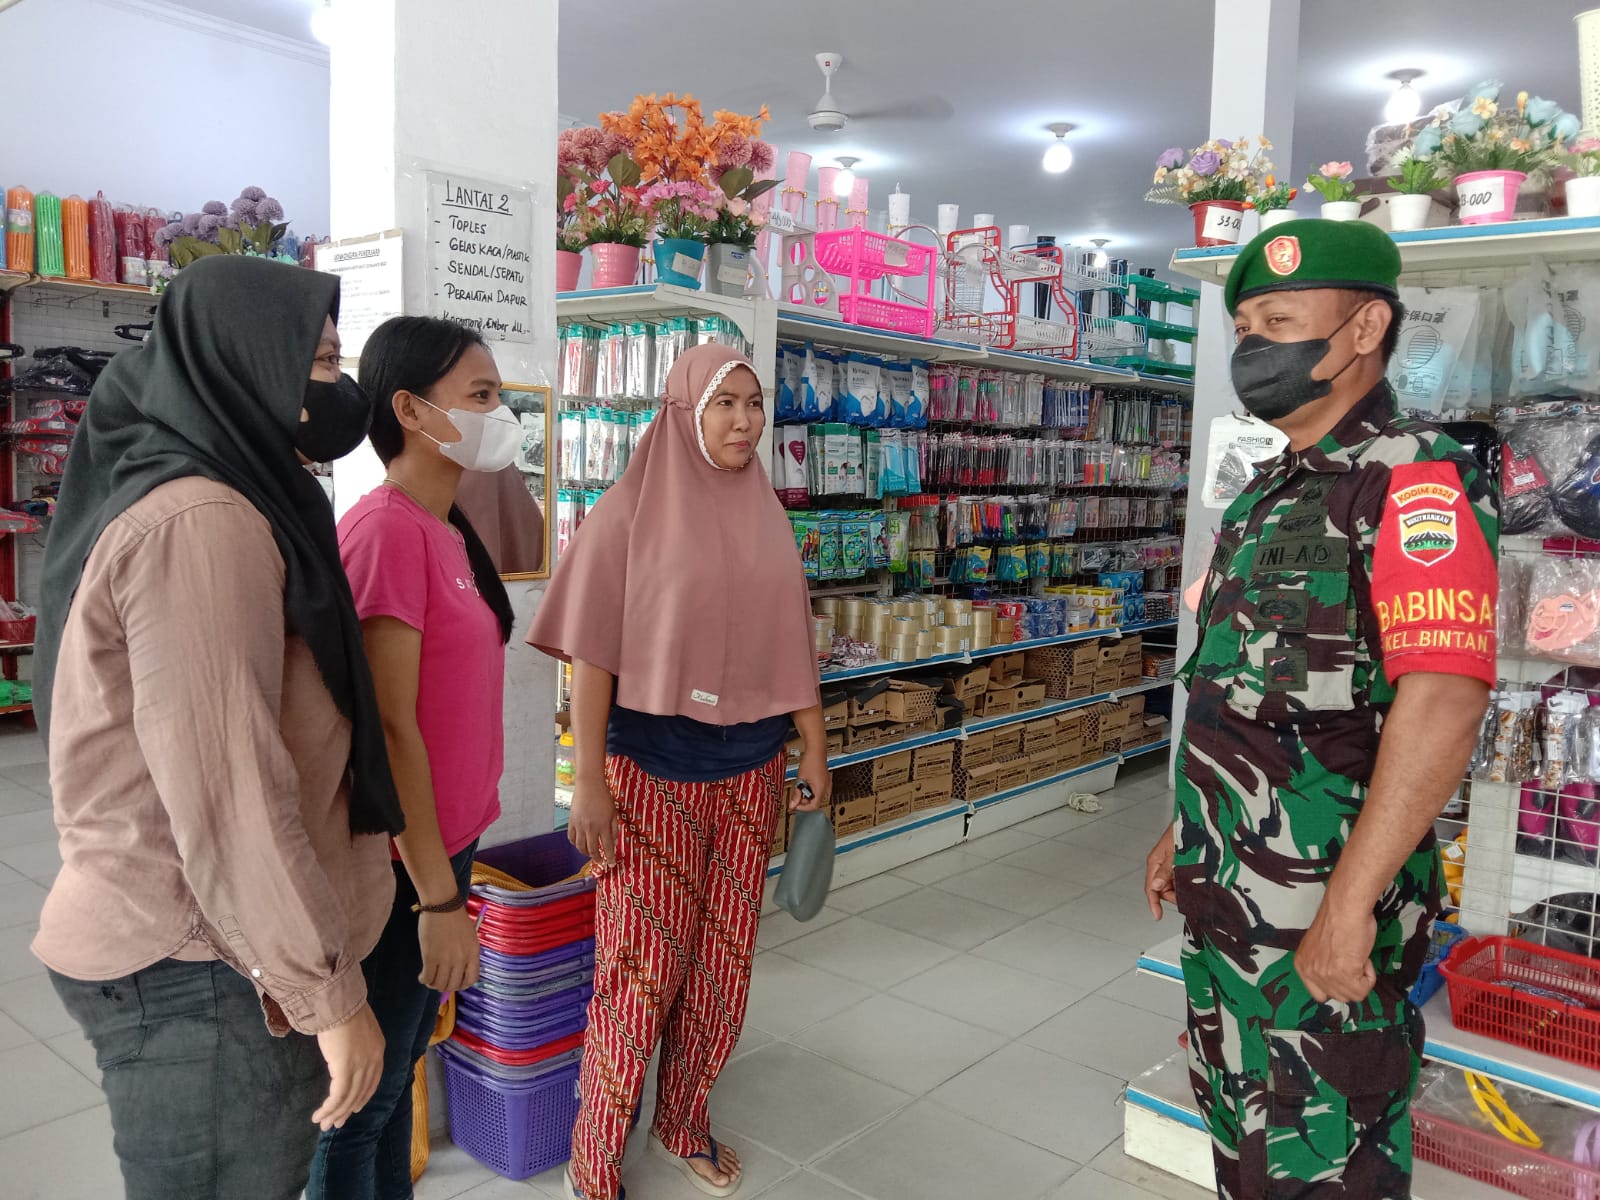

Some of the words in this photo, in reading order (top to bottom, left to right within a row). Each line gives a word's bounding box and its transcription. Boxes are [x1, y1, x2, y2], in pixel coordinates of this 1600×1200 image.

[445, 179, 494, 210] LANTAI
[497, 194, 510, 213] 2
[448, 214, 487, 235] TOPLES
[449, 237, 477, 255] GELAS
[447, 260, 525, 284] SENDAL/SEPATU
[443, 282, 493, 303] PERALATAN
[496, 289, 528, 306] DAPUR
[1237, 435, 1274, 446] FASHION
[1397, 486, 1430, 504] KODIM
[1376, 587, 1494, 633] BABINSA
